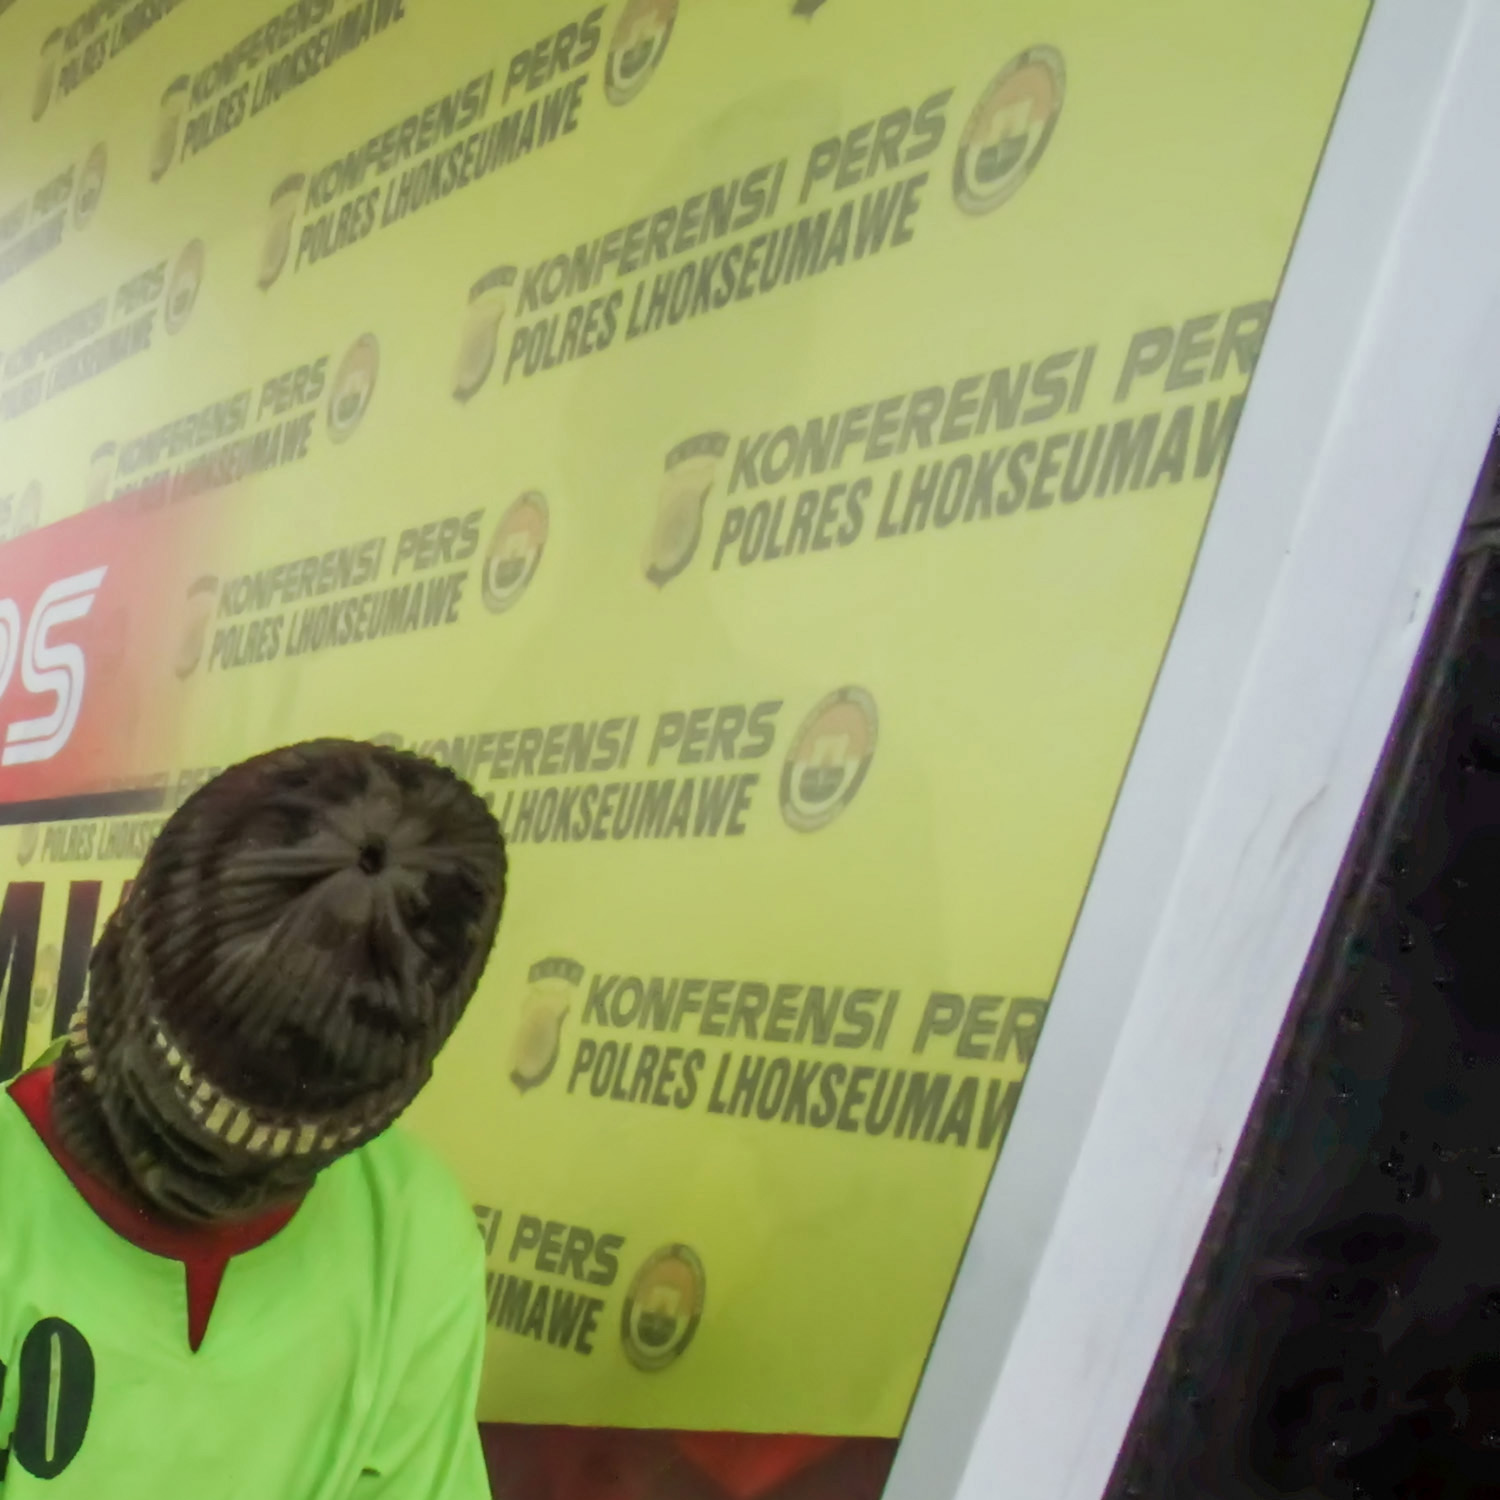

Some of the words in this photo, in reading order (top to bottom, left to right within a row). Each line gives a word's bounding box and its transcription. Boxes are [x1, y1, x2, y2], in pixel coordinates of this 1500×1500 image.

[304, 69, 494, 216] KONFERENSI
[501, 3, 607, 108] PERS
[295, 186, 380, 274] POLRES
[379, 73, 590, 229] LHOKSEUMAWE
[513, 156, 789, 318] KONFERENSI
[798, 86, 956, 206] PERS
[502, 289, 625, 386] POLRES
[624, 171, 931, 342] LHOKSEUMAWE
[255, 354, 331, 422] PERS
[727, 343, 1099, 496] KONFERENSI
[216, 535, 387, 620] KONFERENSI
[390, 506, 487, 577] PERS
[710, 476, 874, 572] POLRES
[207, 613, 285, 673] POLRES
[284, 569, 469, 658] LHOKSEUMAWE
[646, 699, 784, 768] PERS
[499, 773, 761, 847] LHOKSEUMAWE
[580, 973, 901, 1053] KONFERENSI
[911, 990, 1049, 1064] PER
[566, 1036, 706, 1110] POLRES
[508, 1213, 626, 1287] PERS
